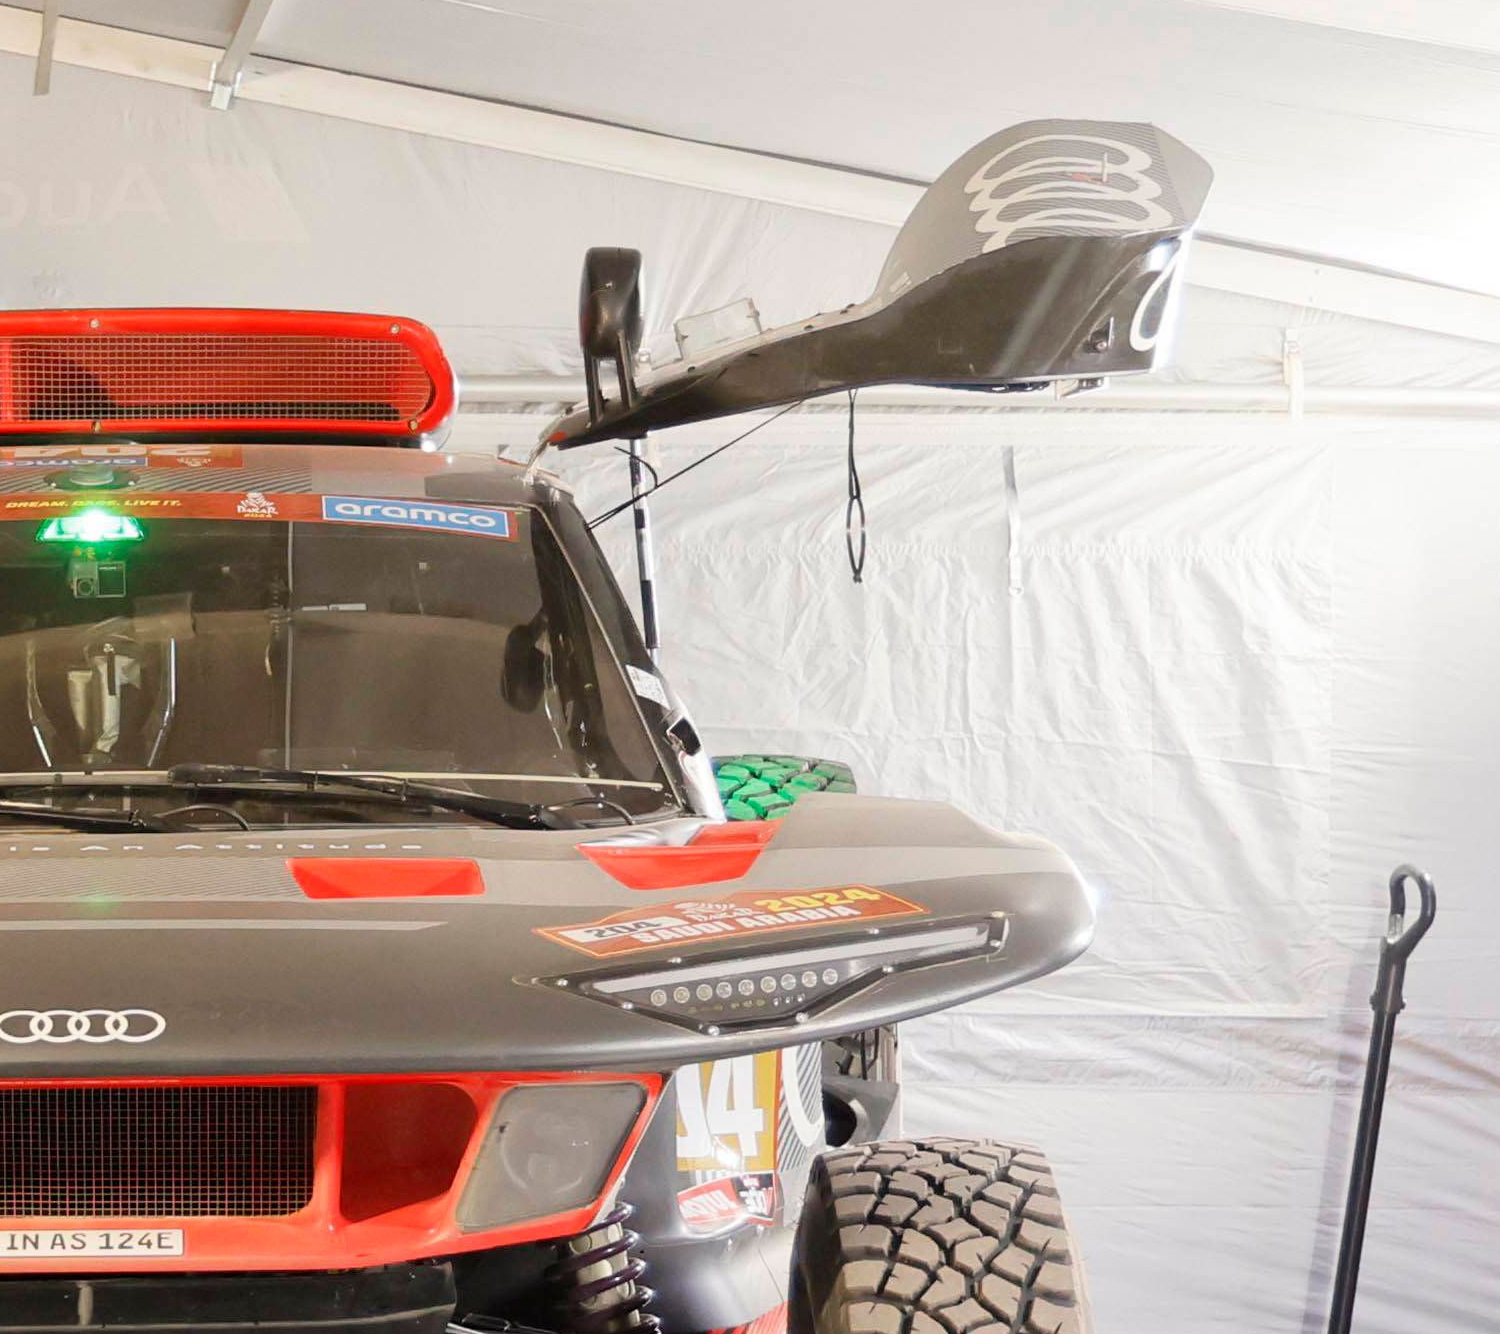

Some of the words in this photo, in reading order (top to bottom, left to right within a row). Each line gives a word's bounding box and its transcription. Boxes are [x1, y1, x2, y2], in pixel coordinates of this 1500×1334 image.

[334, 502, 497, 529] aramco
[754, 888, 882, 914] 2024
[630, 920, 738, 944] SAUDI
[739, 904, 861, 929] ARABIA
[6, 1233, 39, 1251] IN
[50, 1233, 87, 1250] AS
[98, 1231, 174, 1250] 124E
